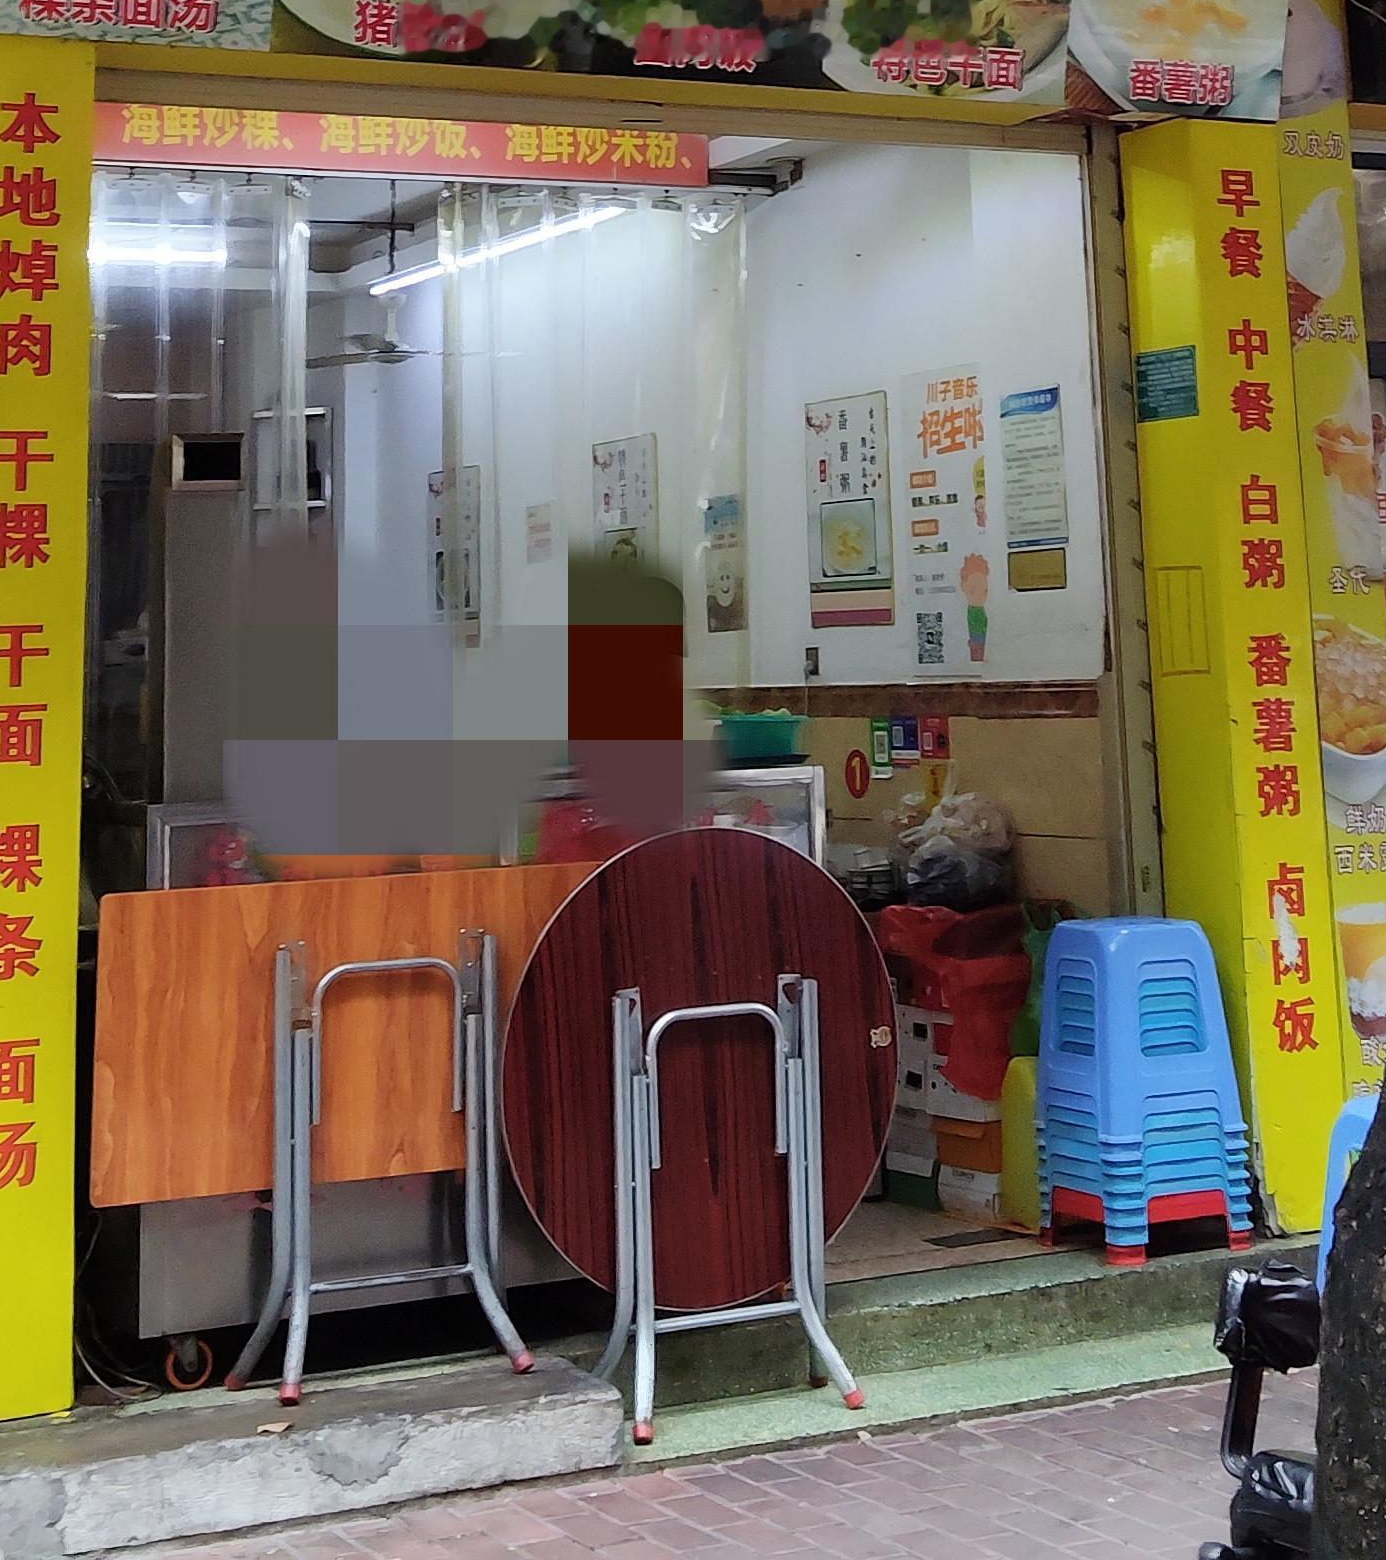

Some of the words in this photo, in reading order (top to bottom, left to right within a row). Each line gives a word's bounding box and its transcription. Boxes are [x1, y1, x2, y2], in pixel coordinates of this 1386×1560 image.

[1129, 58, 1234, 107] 番薯粥
[1282, 130, 1346, 160] 双皮奶
[1217, 169, 1263, 279] 早餐
[1228, 318, 1275, 436] 中餐
[1240, 473, 1286, 590] 白粥
[1247, 631, 1302, 819] 番薯粥
